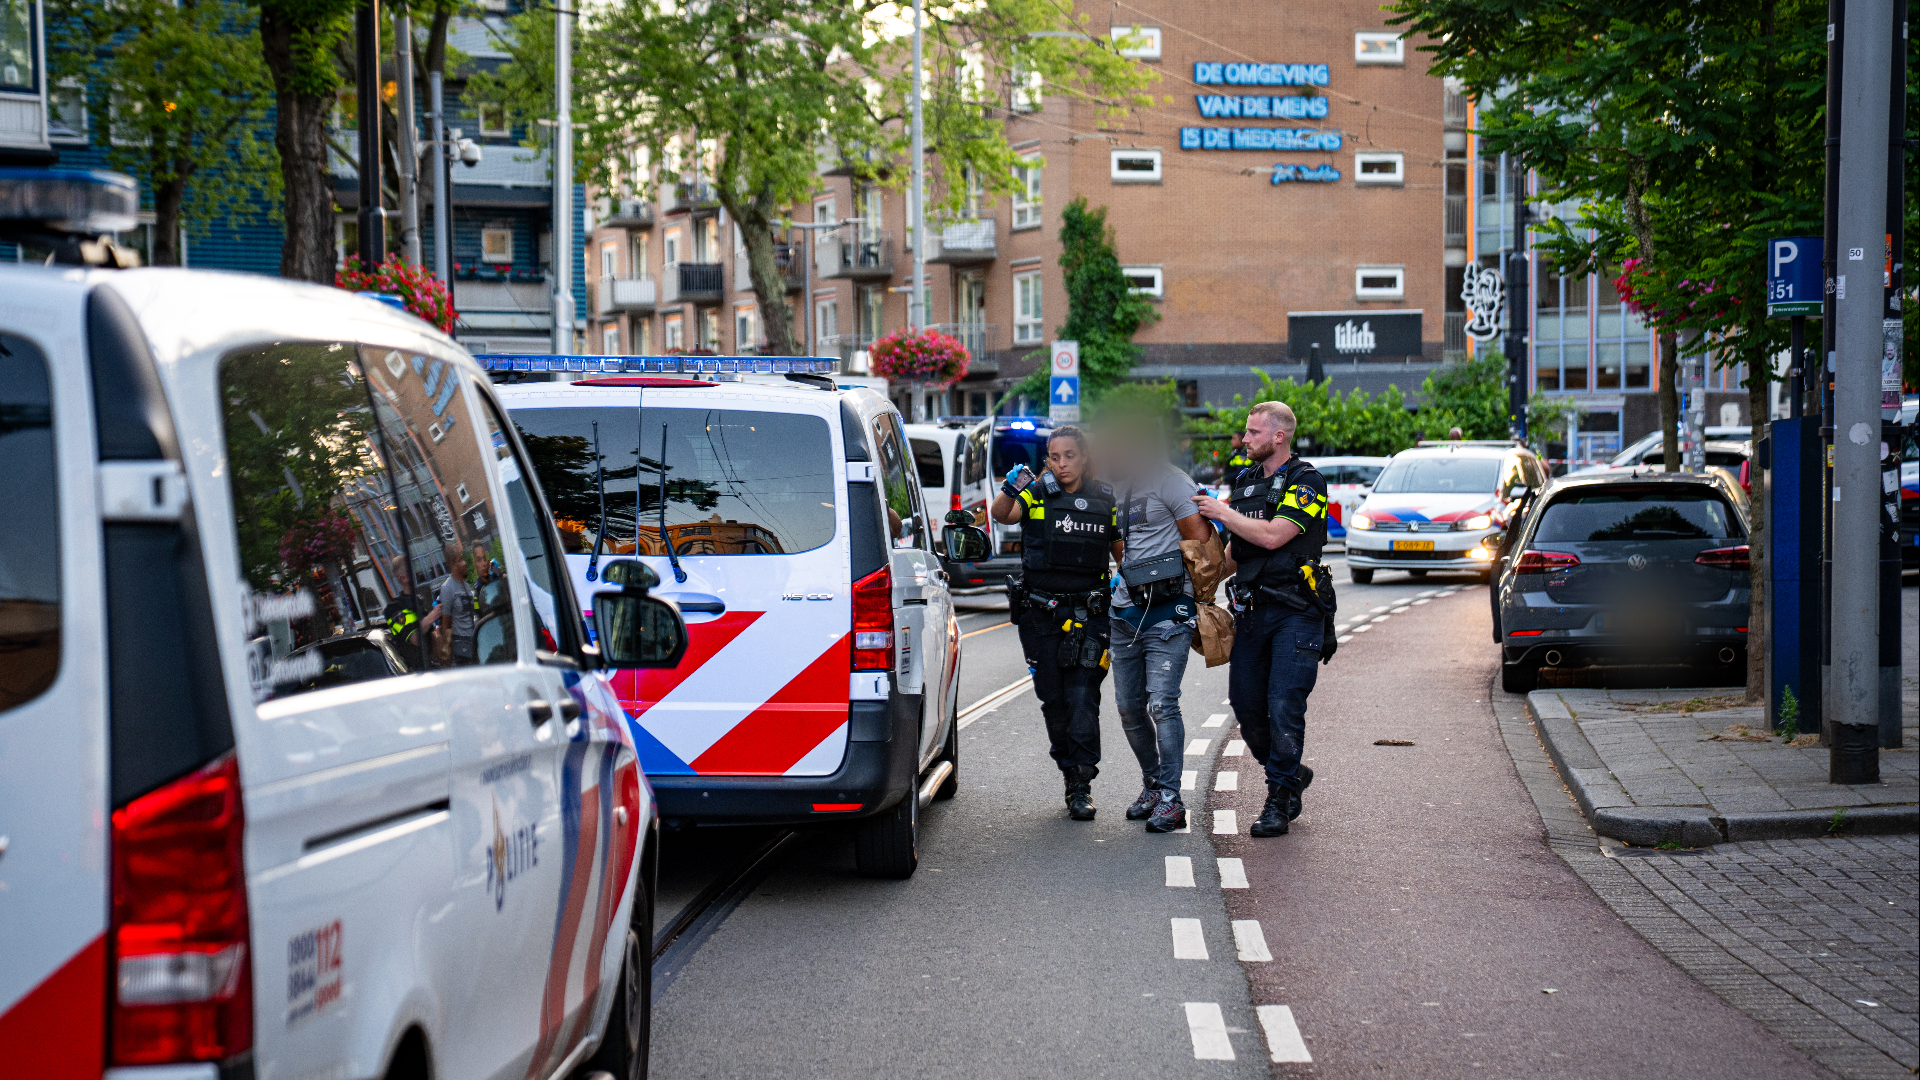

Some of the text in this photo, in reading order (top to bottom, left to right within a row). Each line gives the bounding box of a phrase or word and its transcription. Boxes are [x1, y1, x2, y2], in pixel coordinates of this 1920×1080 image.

[1194, 62, 1329, 85] DE OMGEVING
[1196, 95, 1329, 119] VAN DE MENS
[1181, 127, 1201, 149] IS
[1202, 127, 1231, 149] DE
[1774, 241, 1798, 277] P
[1850, 249, 1861, 257] 50
[1776, 283, 1793, 299] 51
[1055, 516, 1105, 533] POLITIE
[806, 593, 834, 601] CDI
[486, 817, 538, 912] POLITIE
[316, 919, 342, 975] 112
